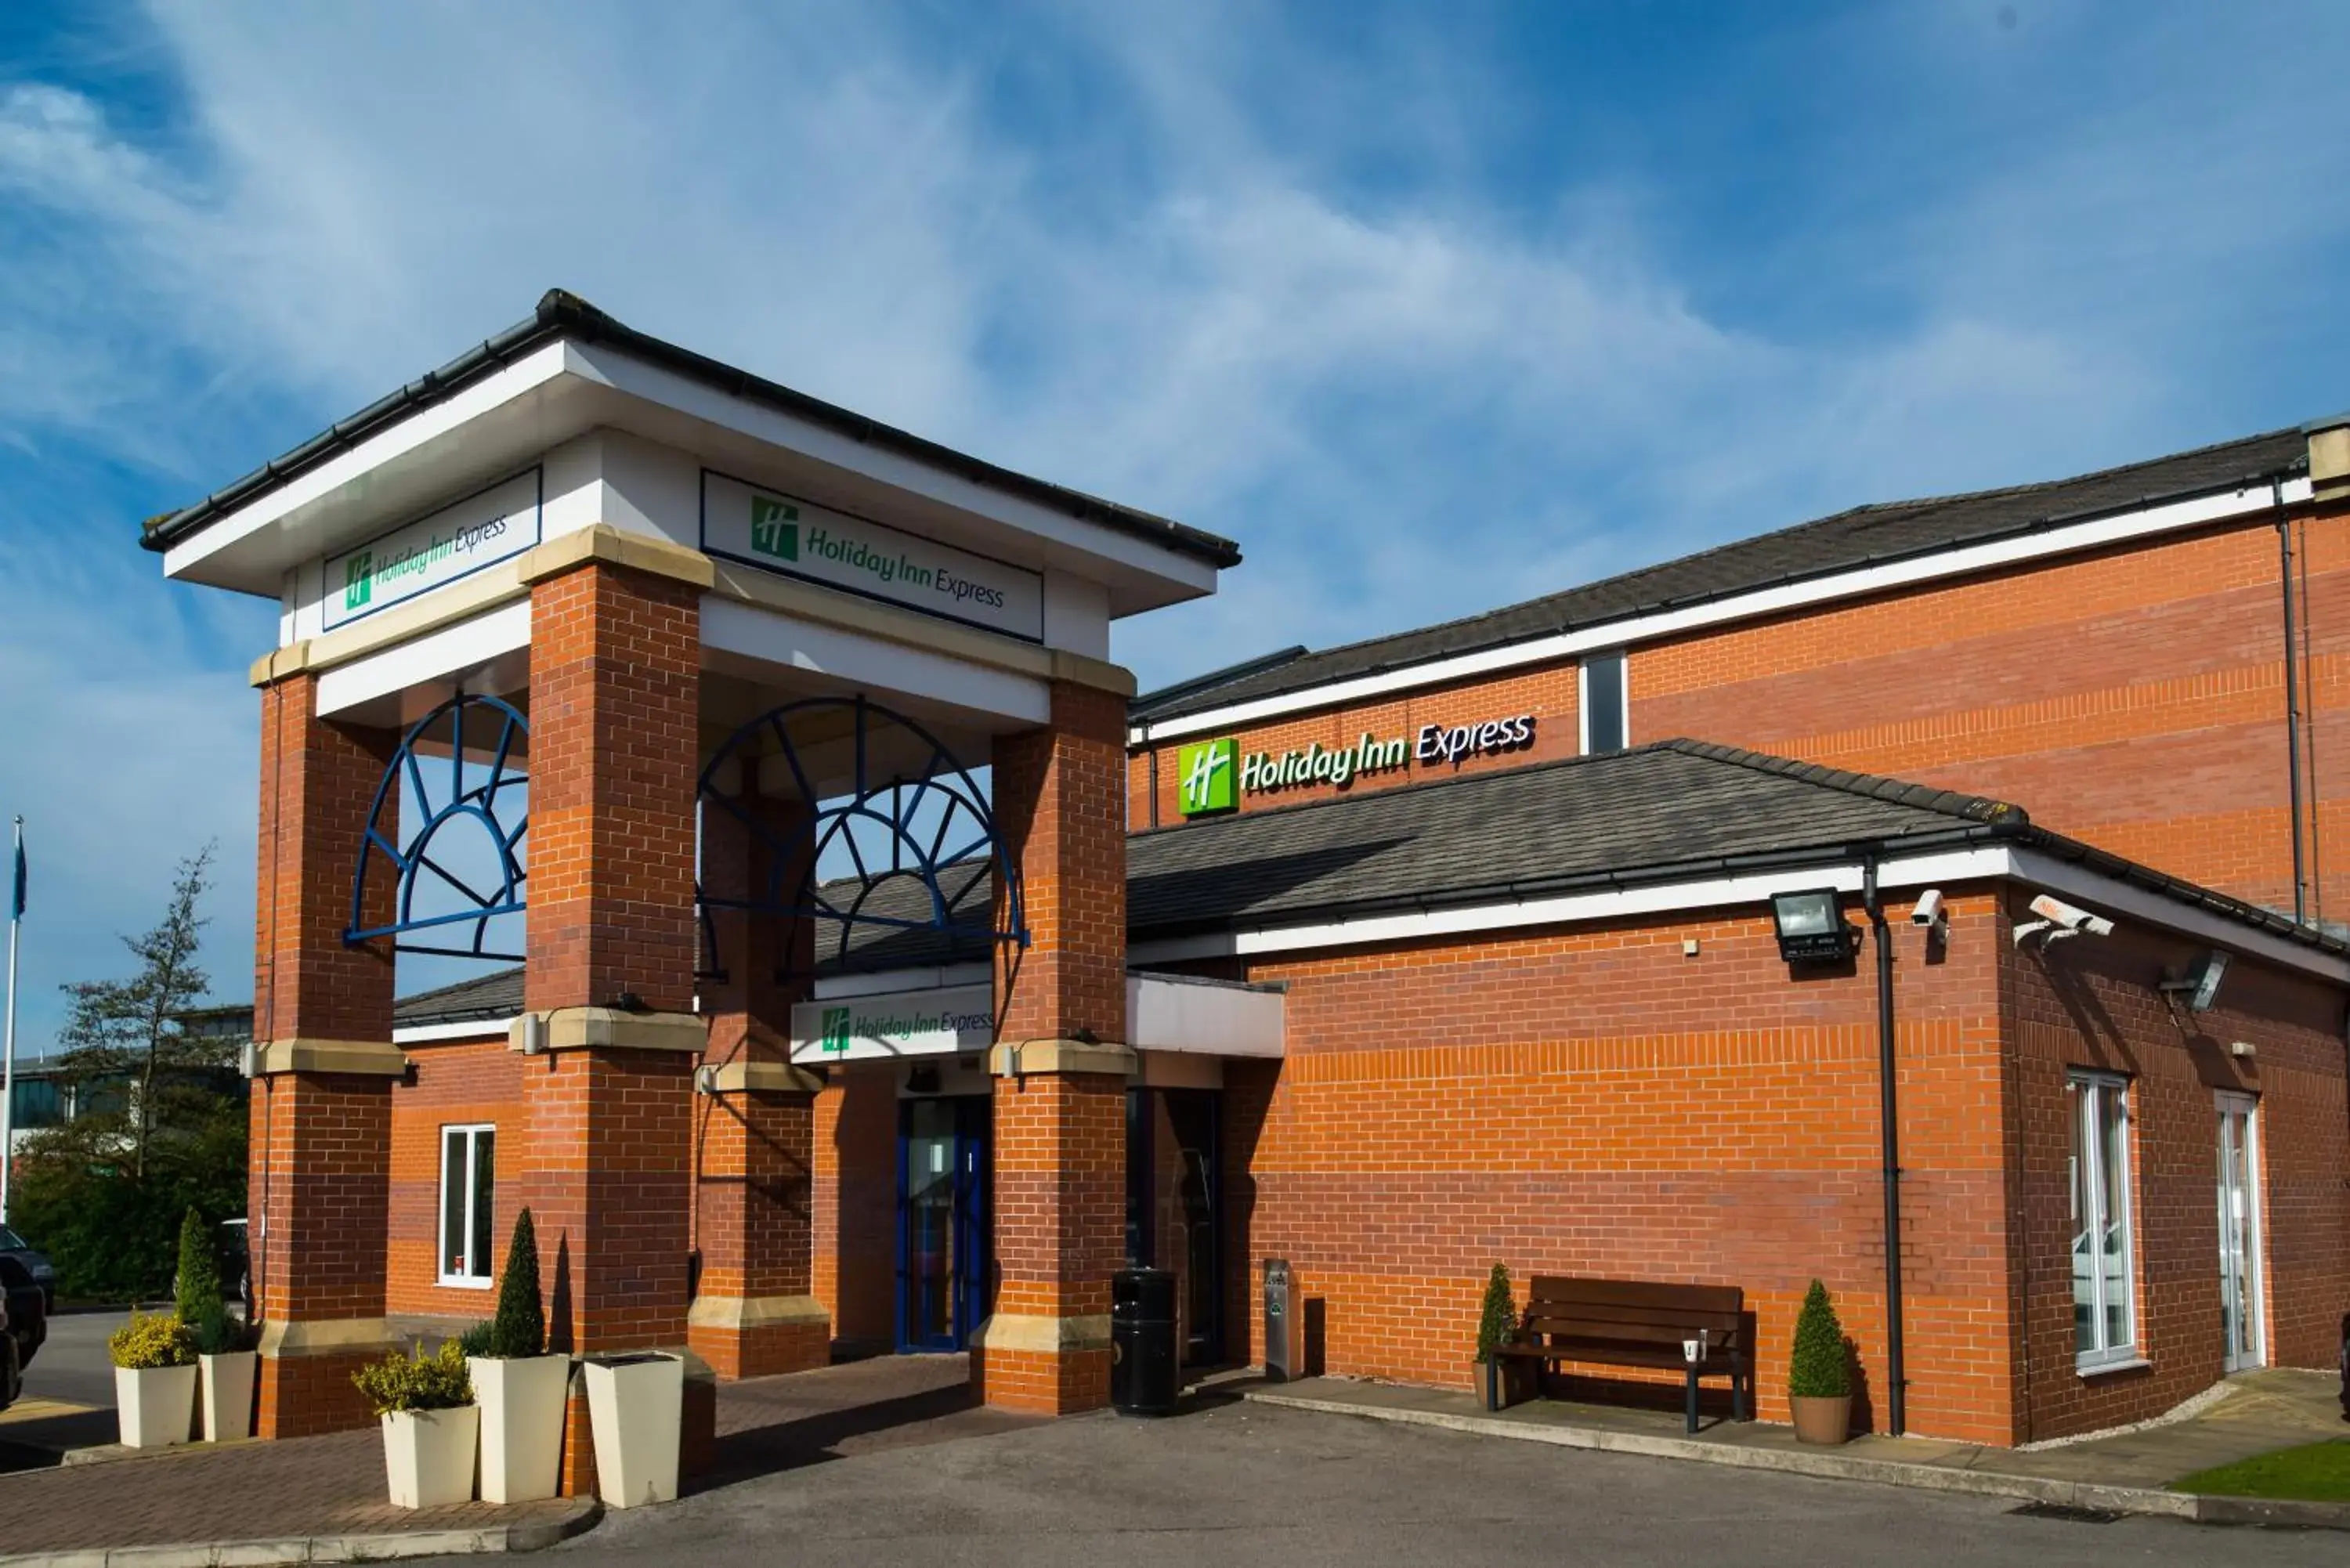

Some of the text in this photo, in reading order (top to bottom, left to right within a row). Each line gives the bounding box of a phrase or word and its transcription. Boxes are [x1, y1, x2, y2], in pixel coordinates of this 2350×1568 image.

[376, 547, 427, 584] Holiday
[430, 535, 454, 563] Inn
[456, 515, 507, 554] Express
[806, 527, 895, 581] Holiday
[898, 555, 931, 587] Inn
[935, 569, 1004, 609] Express
[1240, 743, 1351, 789] Holiday
[1356, 732, 1405, 770] Inn
[1416, 715, 1532, 761] Express
[855, 1015, 911, 1040] Holiday
[914, 1012, 938, 1034] Inn
